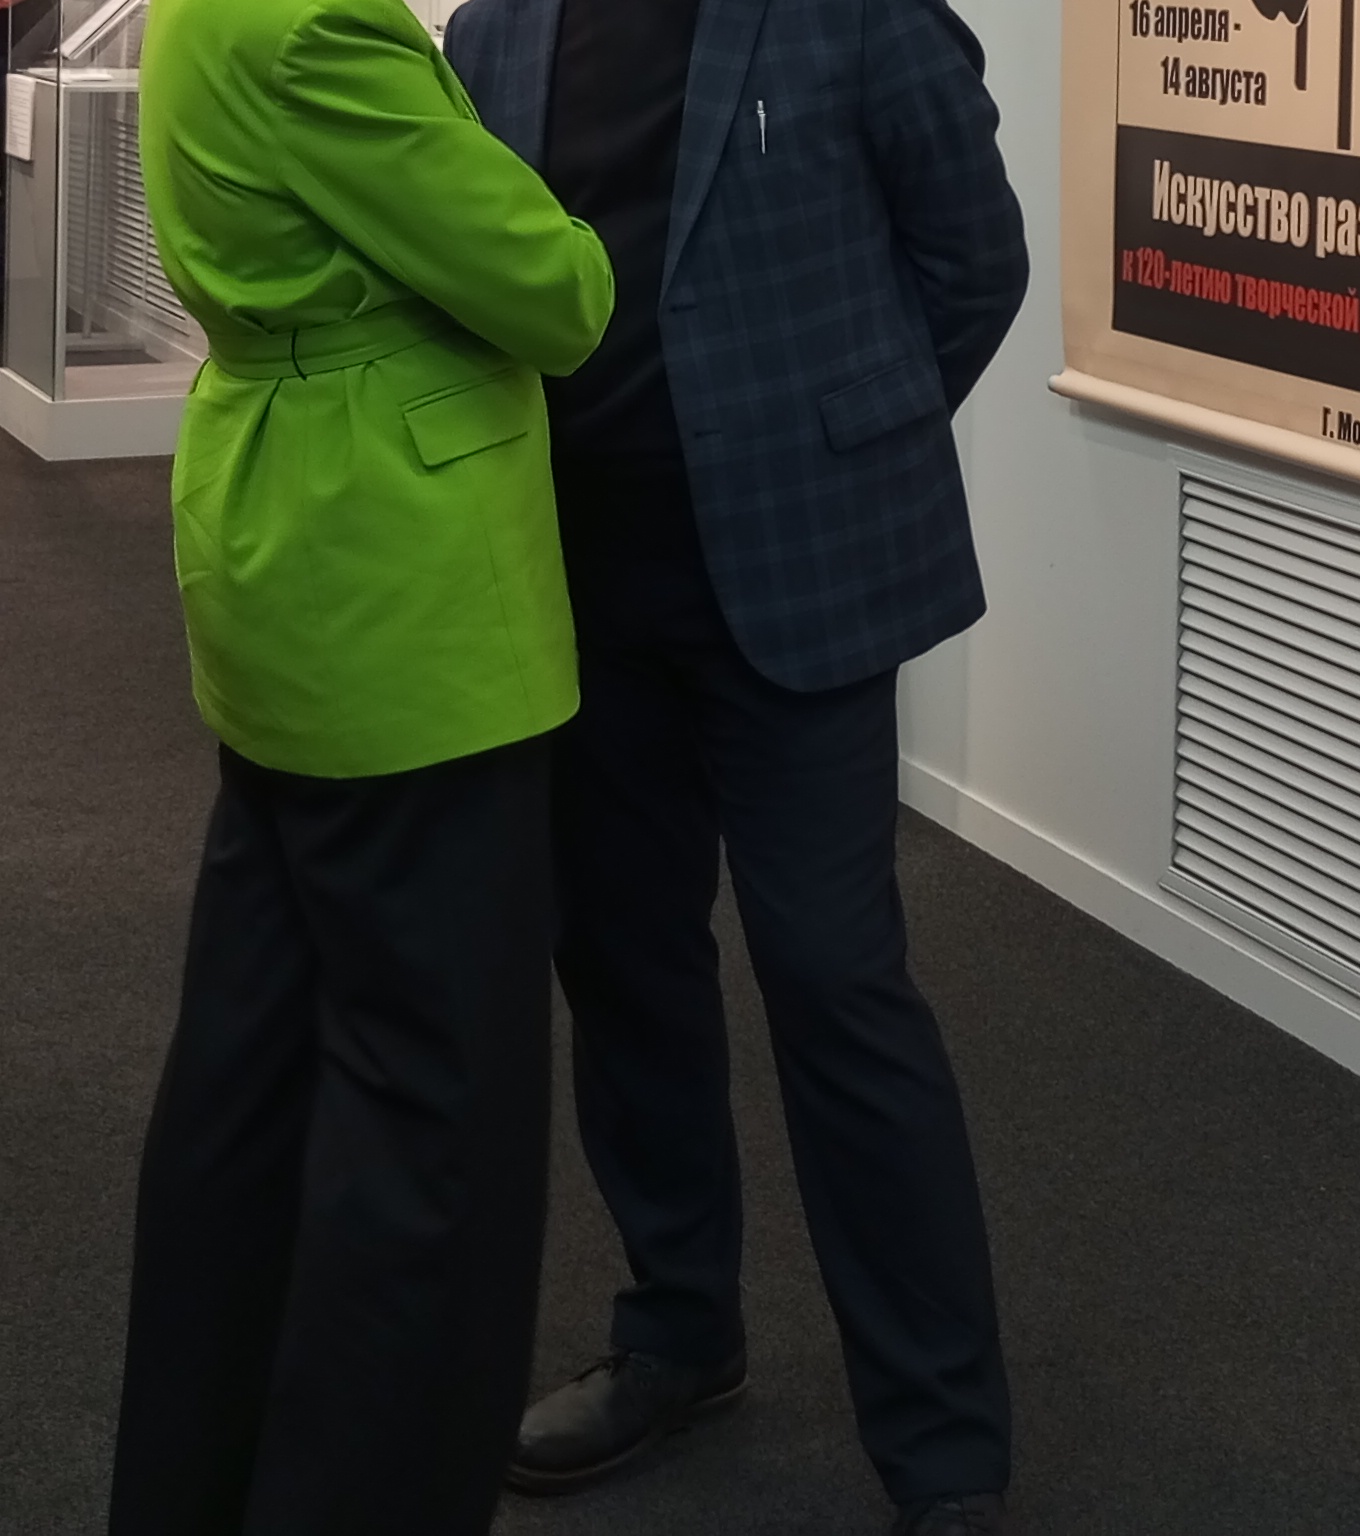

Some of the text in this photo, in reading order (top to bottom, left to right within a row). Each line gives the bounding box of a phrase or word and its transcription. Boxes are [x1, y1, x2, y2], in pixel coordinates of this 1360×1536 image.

[1129, 0, 1150, 38] 16
[1154, 5, 1229, 43] апреля
[1161, 56, 1267, 106] 14 августа
[1152, 159, 1310, 248] Искусство
[1122, 249, 1134, 282] к
[1136, 247, 1231, 304] 120-летию
[1235, 273, 1359, 333] творческой
